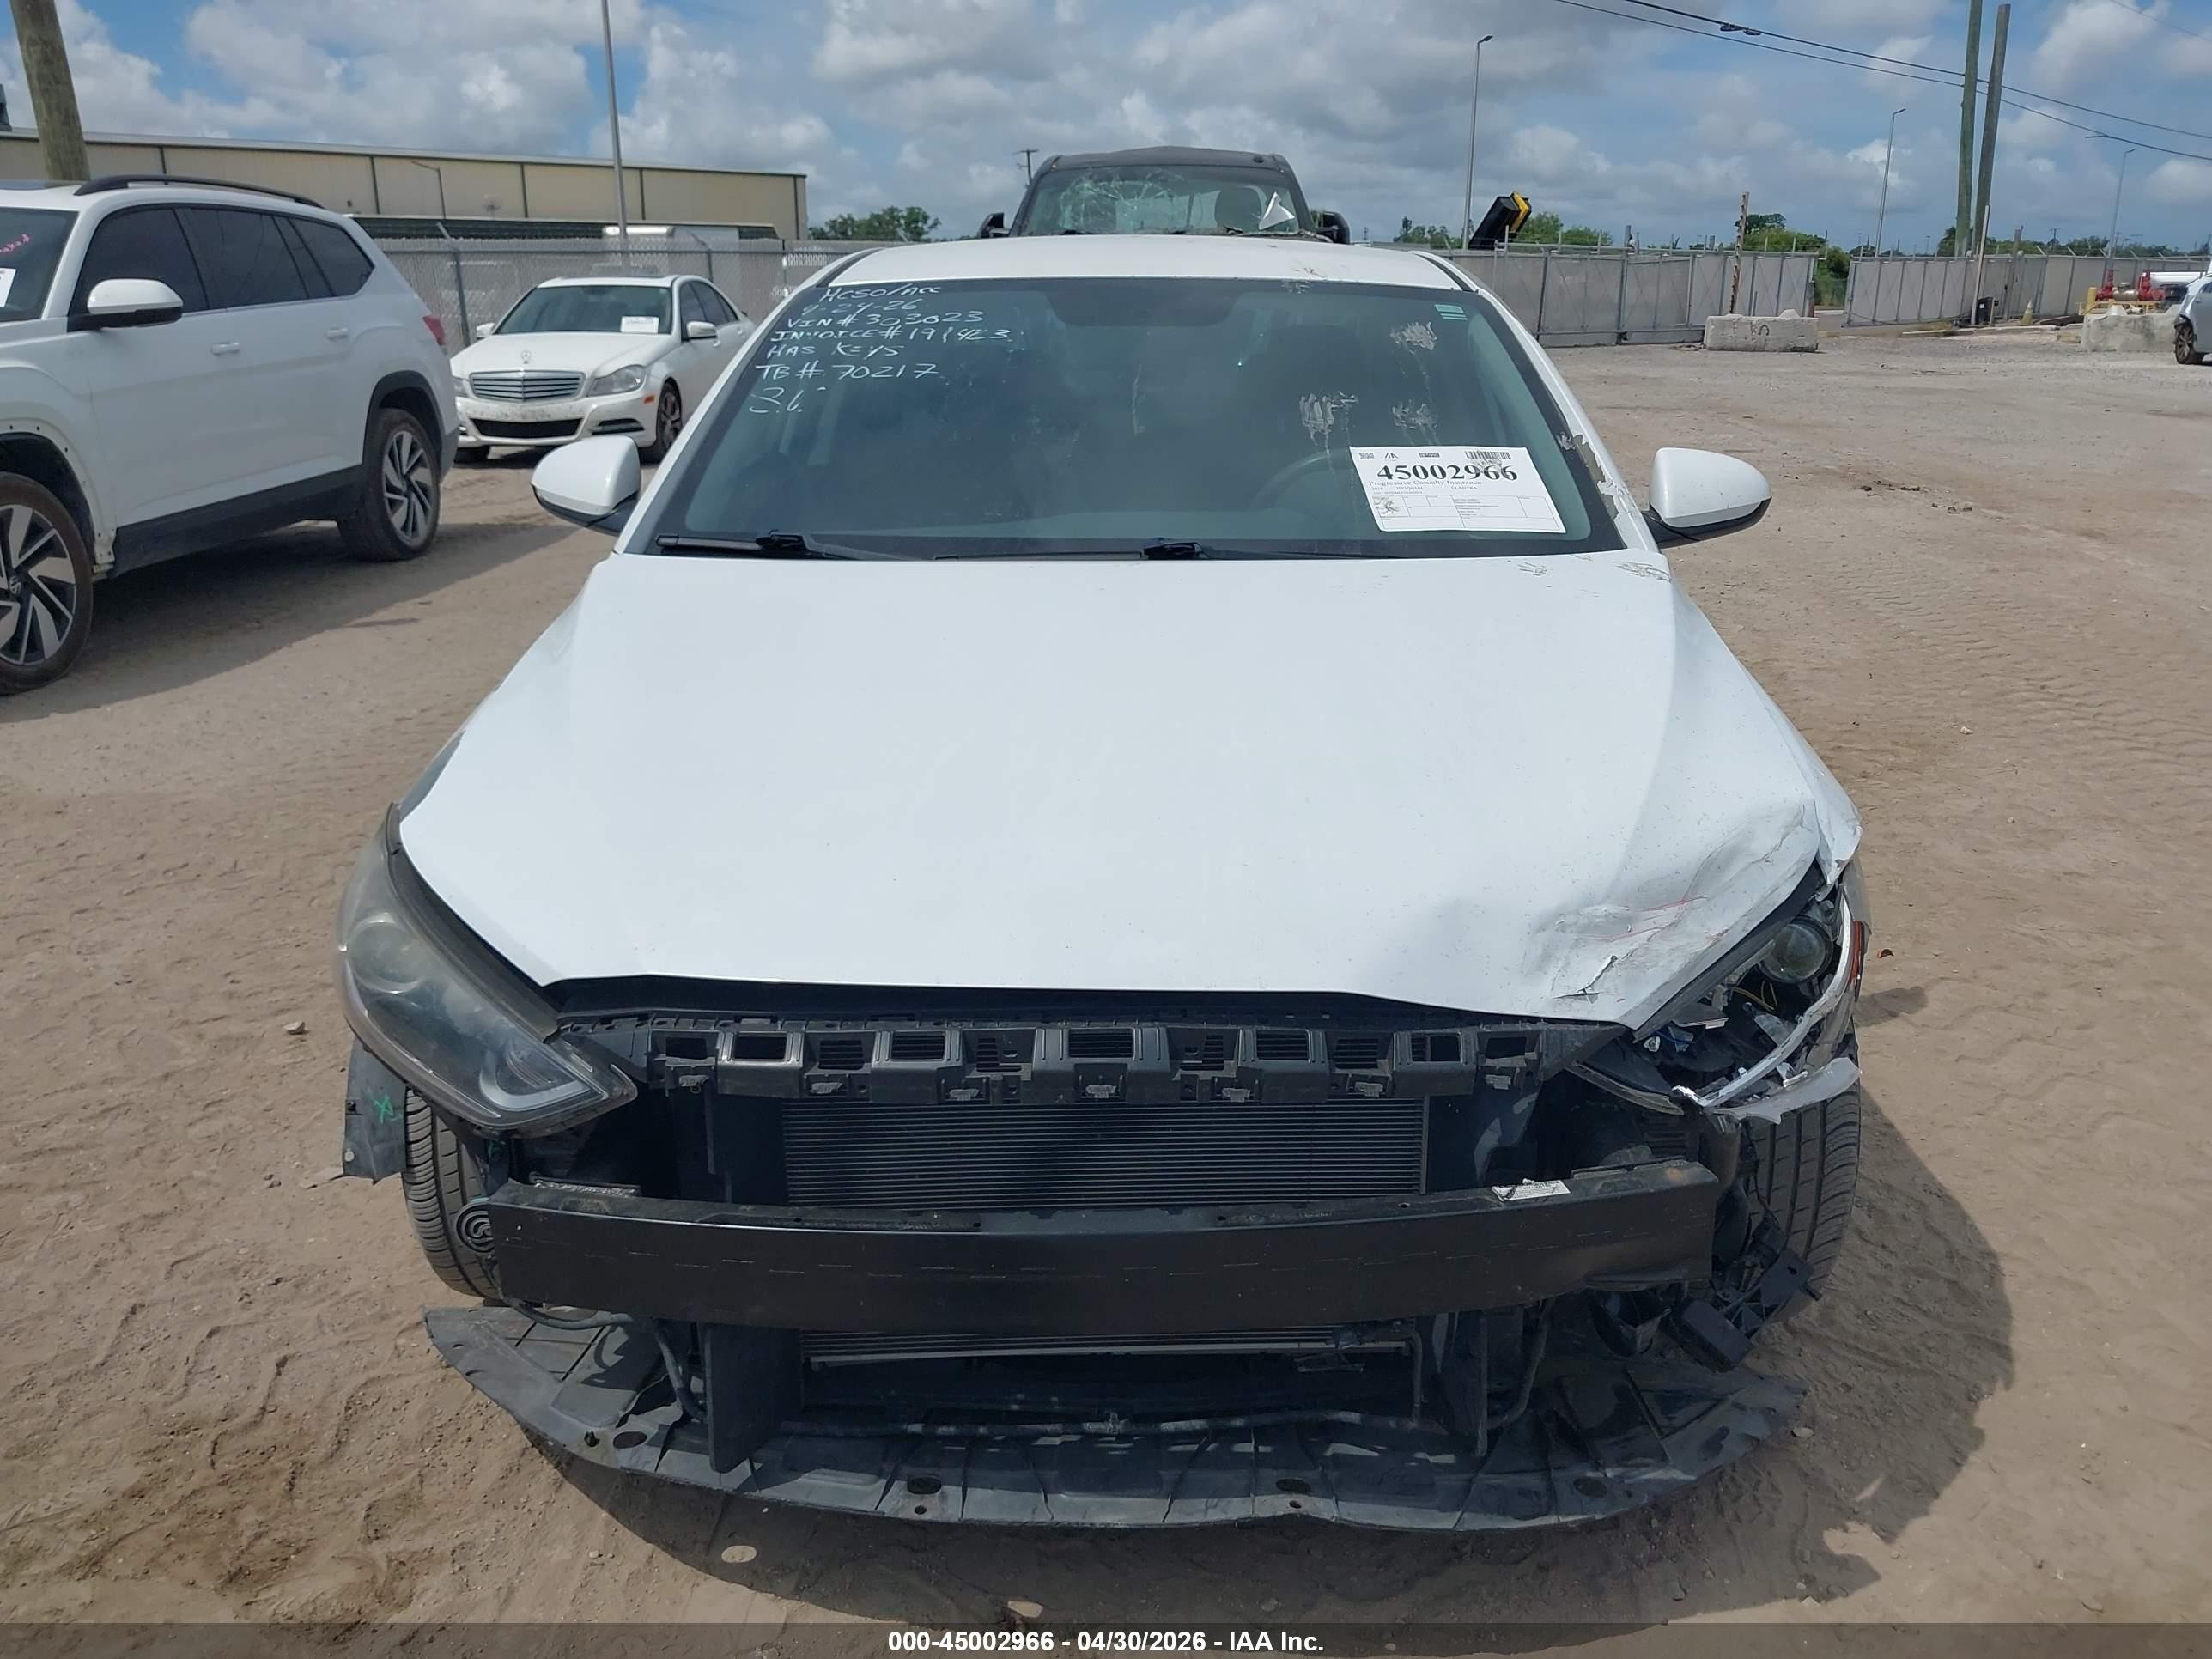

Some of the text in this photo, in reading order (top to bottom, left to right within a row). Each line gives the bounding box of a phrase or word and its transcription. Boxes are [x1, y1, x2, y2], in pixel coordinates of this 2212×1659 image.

[866, 311, 984, 326] 303023
[766, 342, 905, 360] HAS KEYS
[831, 363, 939, 380] 70217
[1376, 465, 1518, 481] 45002966
